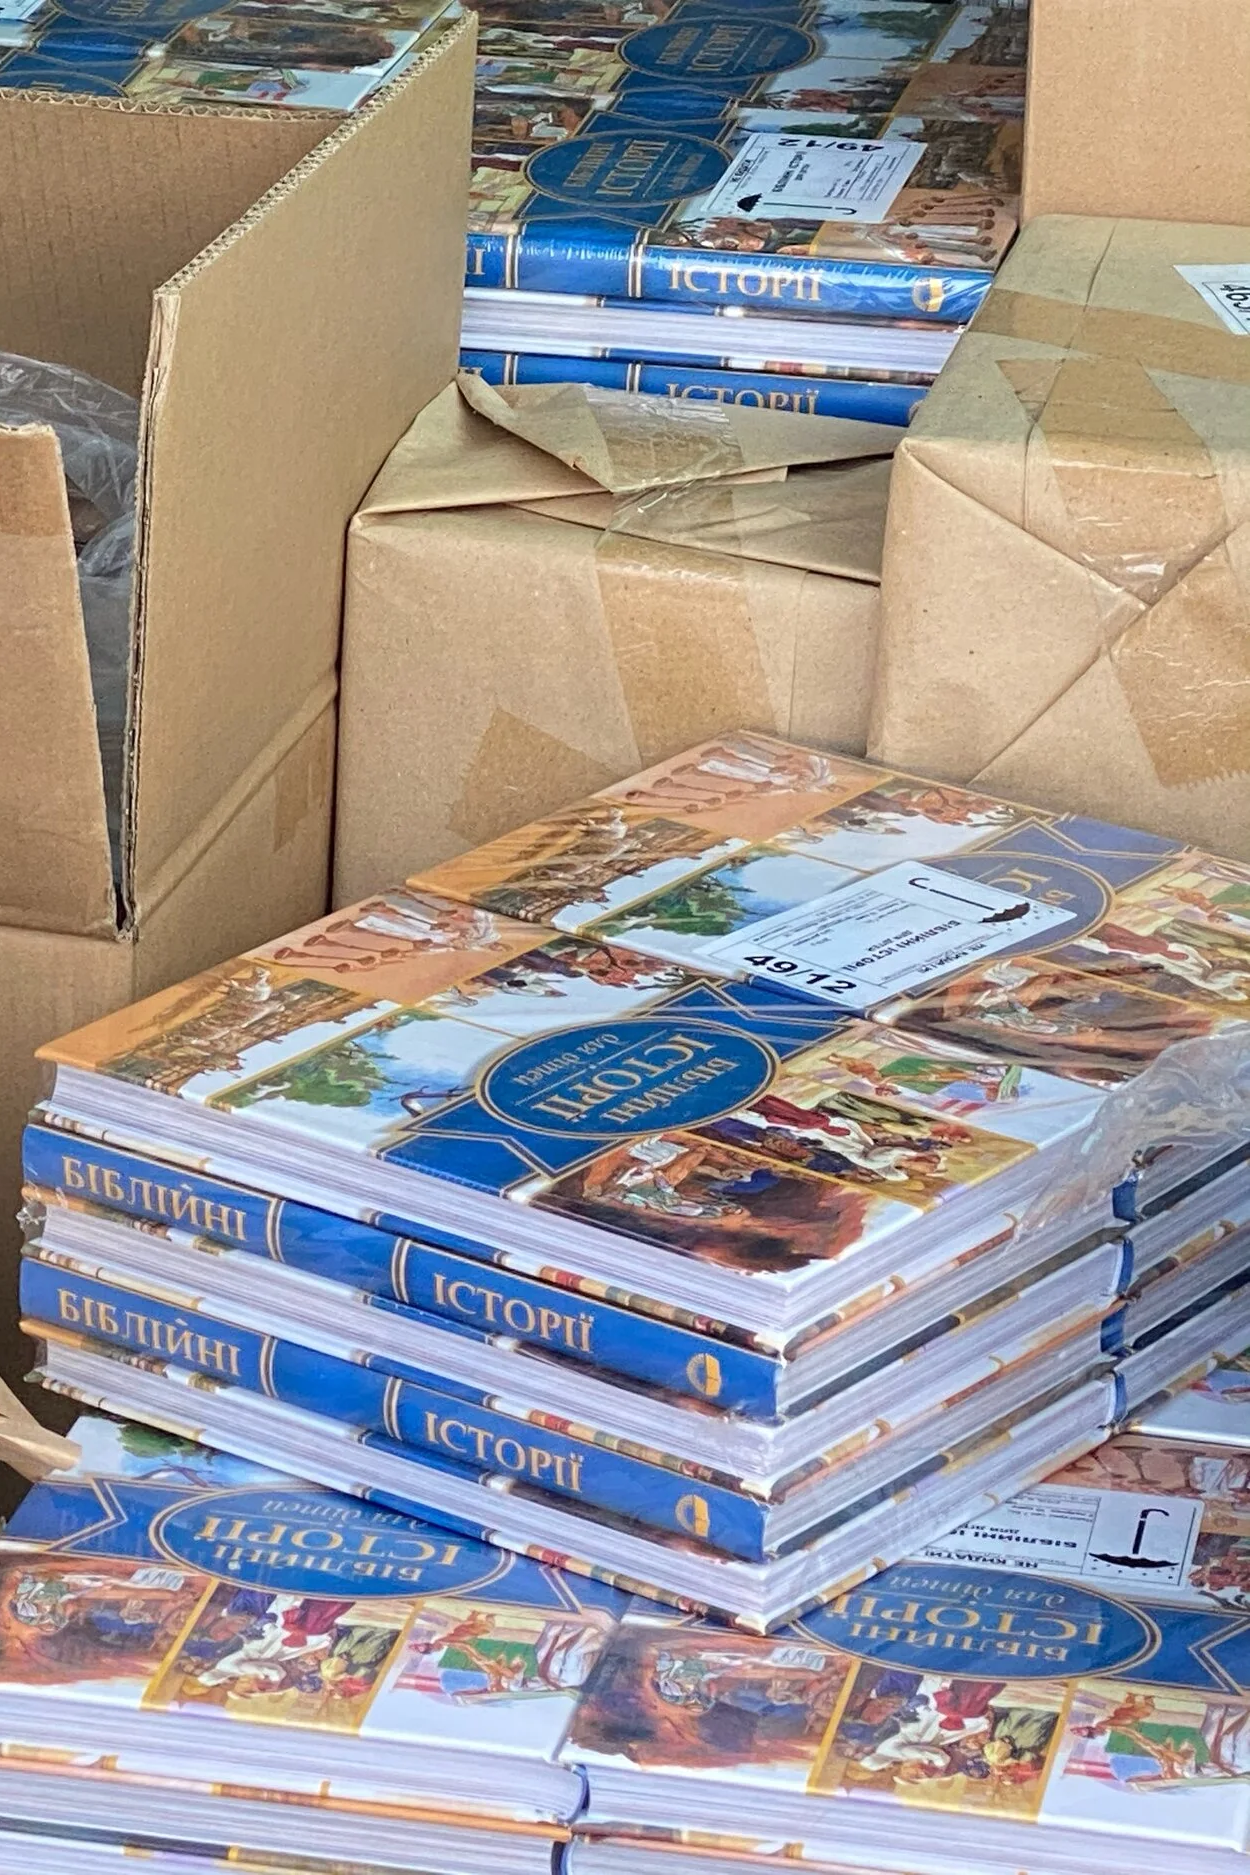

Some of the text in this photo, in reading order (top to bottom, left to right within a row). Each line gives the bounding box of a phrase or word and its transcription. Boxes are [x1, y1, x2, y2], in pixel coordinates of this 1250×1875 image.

[777, 138, 884, 151] 49/12
[668, 262, 824, 301] ІСТОРІЇ
[743, 954, 857, 995] 49/12
[531, 1033, 717, 1123] ІСТОРІЇ
[600, 1056, 740, 1124] БІБЛІЙНІ
[62, 1155, 595, 1353] БІБЛІЙНІ ІСТОРІЇ
[58, 1288, 585, 1493] БІБЛІЙНІ ІСТОРІЇ
[194, 1516, 462, 1566] ІСТОРІЇ
[973, 1531, 1077, 1548] БІБЛІЙНІ
[214, 1544, 423, 1582] БІБЛІЙНІ
[825, 1593, 1106, 1645] ІСТОРІЇ
[850, 1623, 1068, 1662] БІБЛІЙНІ
